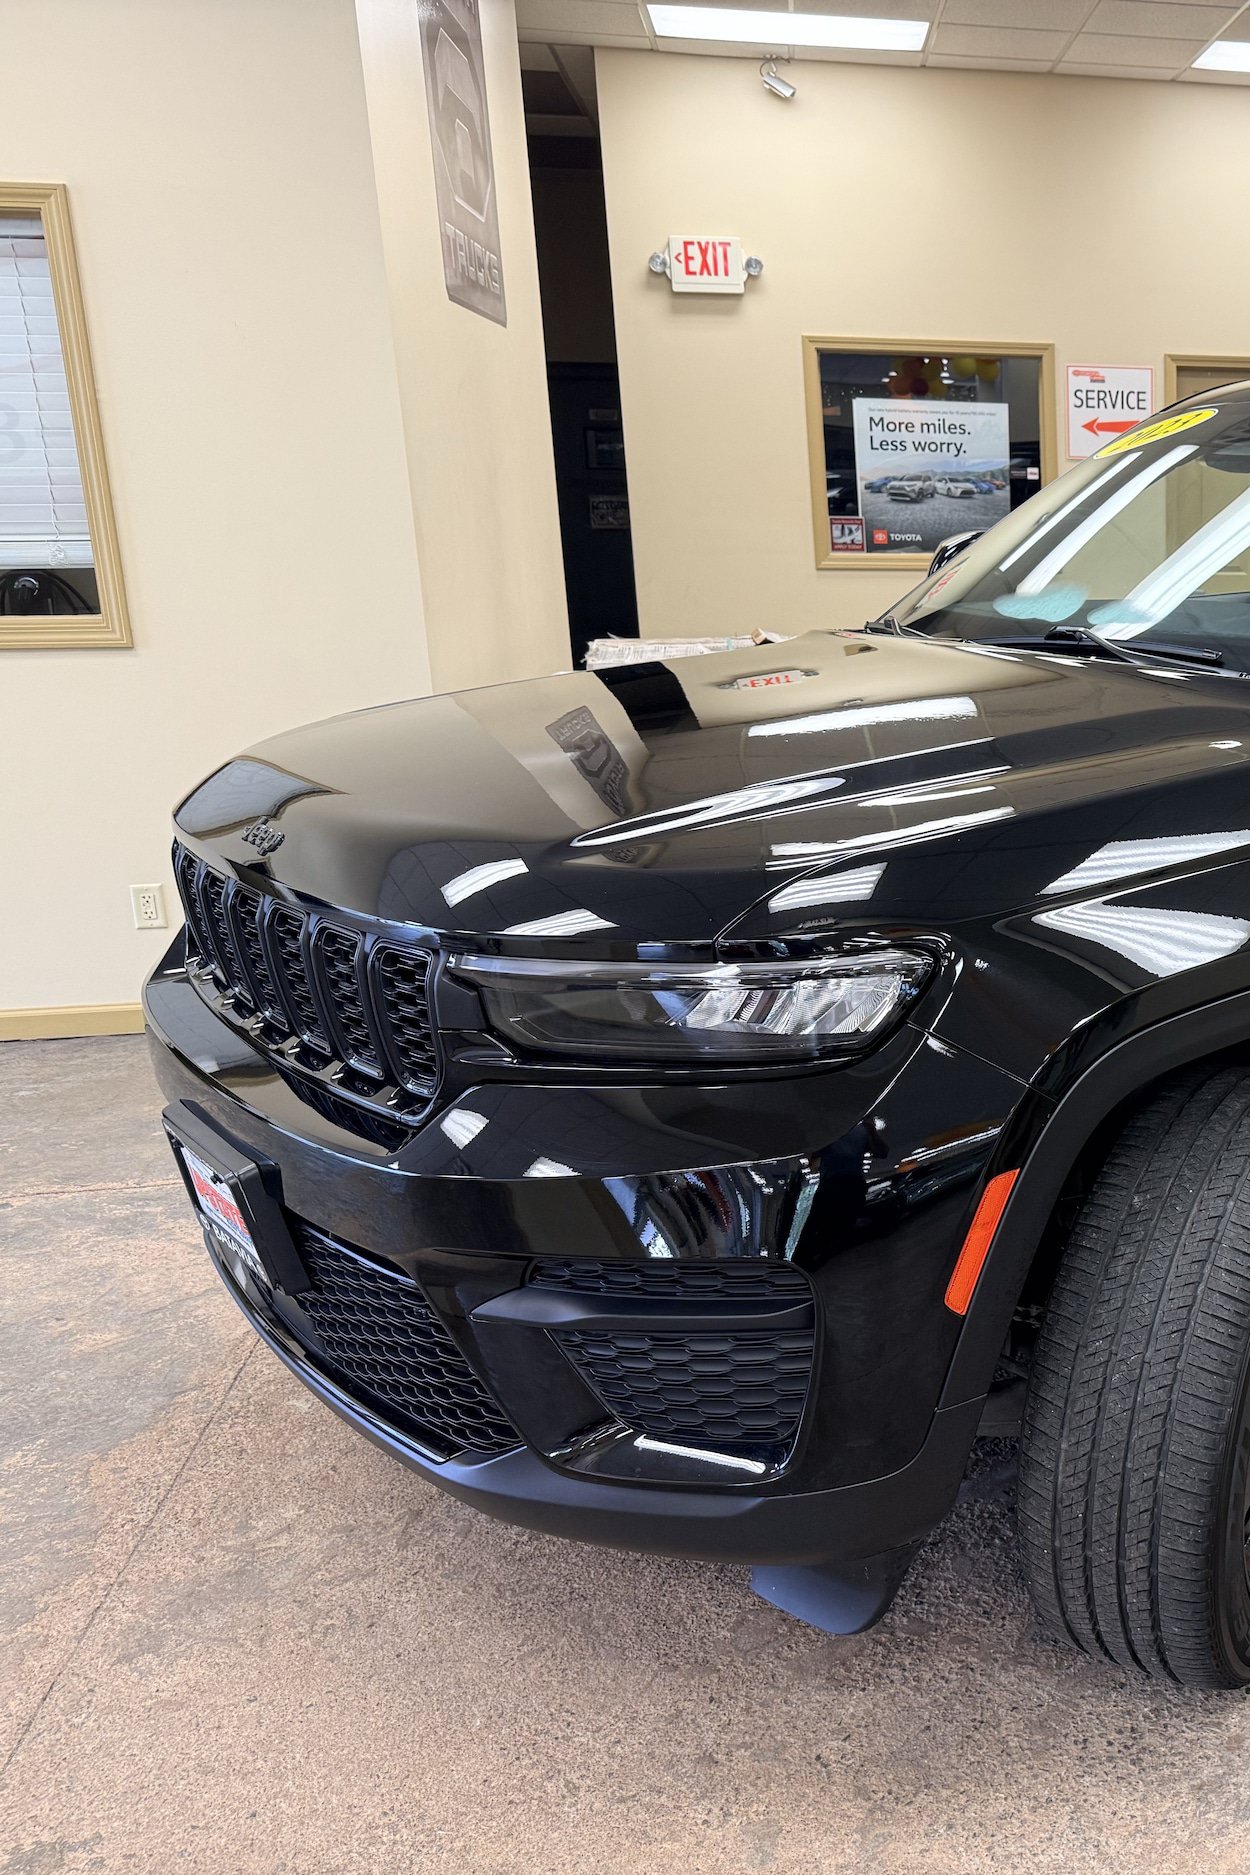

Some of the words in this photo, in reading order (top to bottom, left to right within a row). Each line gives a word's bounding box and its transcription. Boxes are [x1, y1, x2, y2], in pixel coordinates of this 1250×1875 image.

[444, 221, 501, 295] TRUCKS
[683, 240, 731, 277] EXIT
[1073, 388, 1147, 410] SERVICE
[869, 416, 915, 432] More
[920, 418, 971, 435] miles.
[870, 435, 907, 451] Less
[912, 440, 967, 457] worry.
[890, 533, 922, 542] TOYOTA
